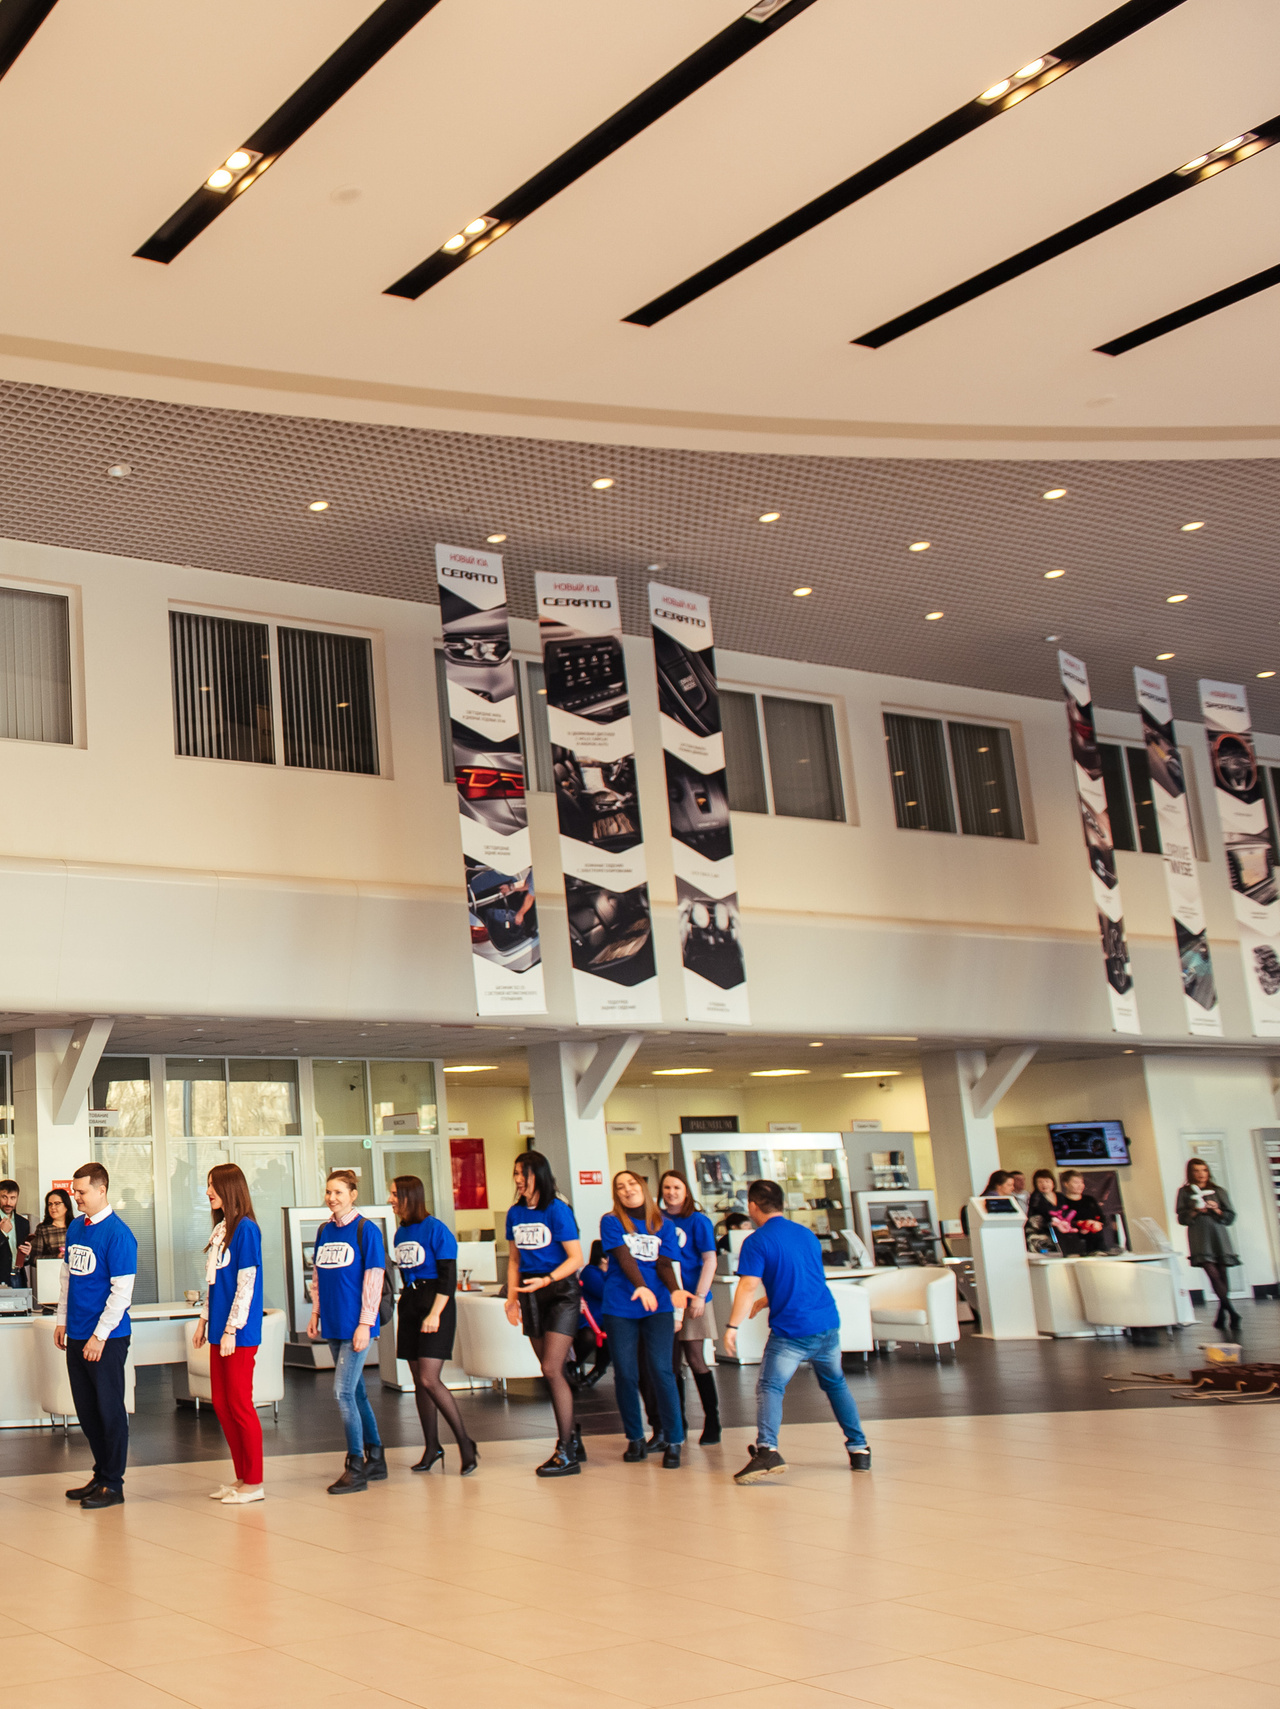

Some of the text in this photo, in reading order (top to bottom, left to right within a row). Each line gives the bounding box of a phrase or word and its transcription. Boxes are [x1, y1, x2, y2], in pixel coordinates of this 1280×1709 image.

[441, 567, 498, 585] CERATO
[543, 597, 612, 609] CERATO
[654, 608, 706, 628] CERATO
